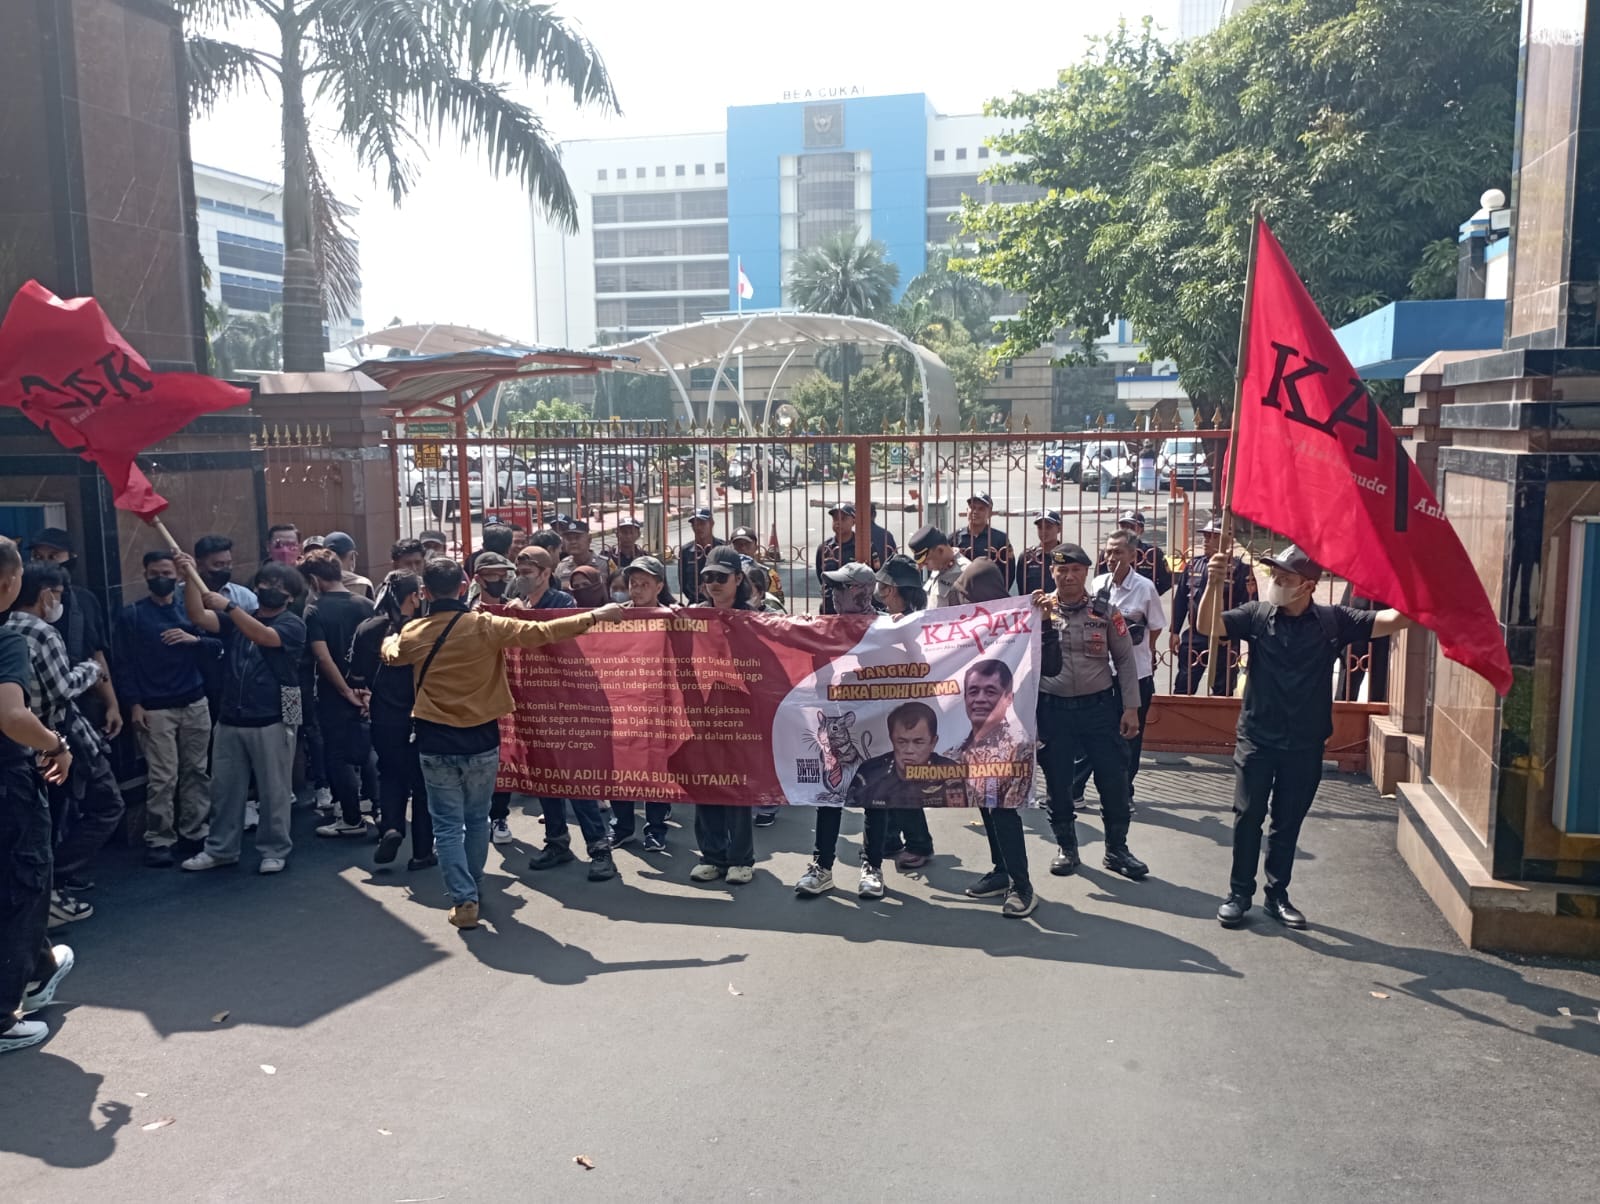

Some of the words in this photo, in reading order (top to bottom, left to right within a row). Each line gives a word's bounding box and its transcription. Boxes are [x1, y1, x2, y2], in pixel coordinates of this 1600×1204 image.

[783, 88, 812, 100] BEA
[818, 84, 865, 98] CUKAI
[605, 618, 646, 632] BERSIH
[648, 618, 672, 632] BEA
[674, 618, 708, 632] CUKAI
[922, 606, 1032, 655] KAPAK
[632, 656, 660, 666] segera
[734, 658, 760, 667] Budhi
[600, 668, 637, 678] Jenderal
[675, 668, 700, 677] Cukai
[725, 672, 762, 682] menjaga
[854, 663, 930, 680] TANGKAP
[870, 683, 910, 700] BUDHI
[910, 680, 960, 698] UTAMA
[527, 702, 556, 710] Komisi
[558, 702, 625, 713] Pemberantasan
[628, 704, 658, 714] Korupsi
[661, 704, 682, 715] (KPK)
[684, 706, 702, 714] dan
[704, 706, 750, 716] Kejaksaan
[550, 716, 579, 724] segera
[630, 717, 652, 726] Djaka
[680, 720, 710, 728] Utama
[536, 728, 567, 736] terkait
[568, 728, 601, 738] dugaan
[654, 731, 678, 740] aliran
[680, 732, 702, 740] dana
[705, 732, 734, 740] dalam
[736, 732, 762, 740] kasus
[533, 741, 566, 750] Blueray
[568, 741, 596, 750] Cargo.
[544, 768, 570, 780] DAN
[574, 769, 606, 780] ADILI
[612, 770, 650, 782] DJAKA
[652, 772, 688, 784] BUDHI
[692, 774, 740, 786] UTAMA
[743, 774, 747, 785] !
[905, 764, 966, 780] BURONAN
[968, 762, 1022, 778] RAKYAT
[496, 778, 519, 788] BEA
[551, 784, 600, 796] SARANG
[604, 786, 677, 799] PENYAMUN
